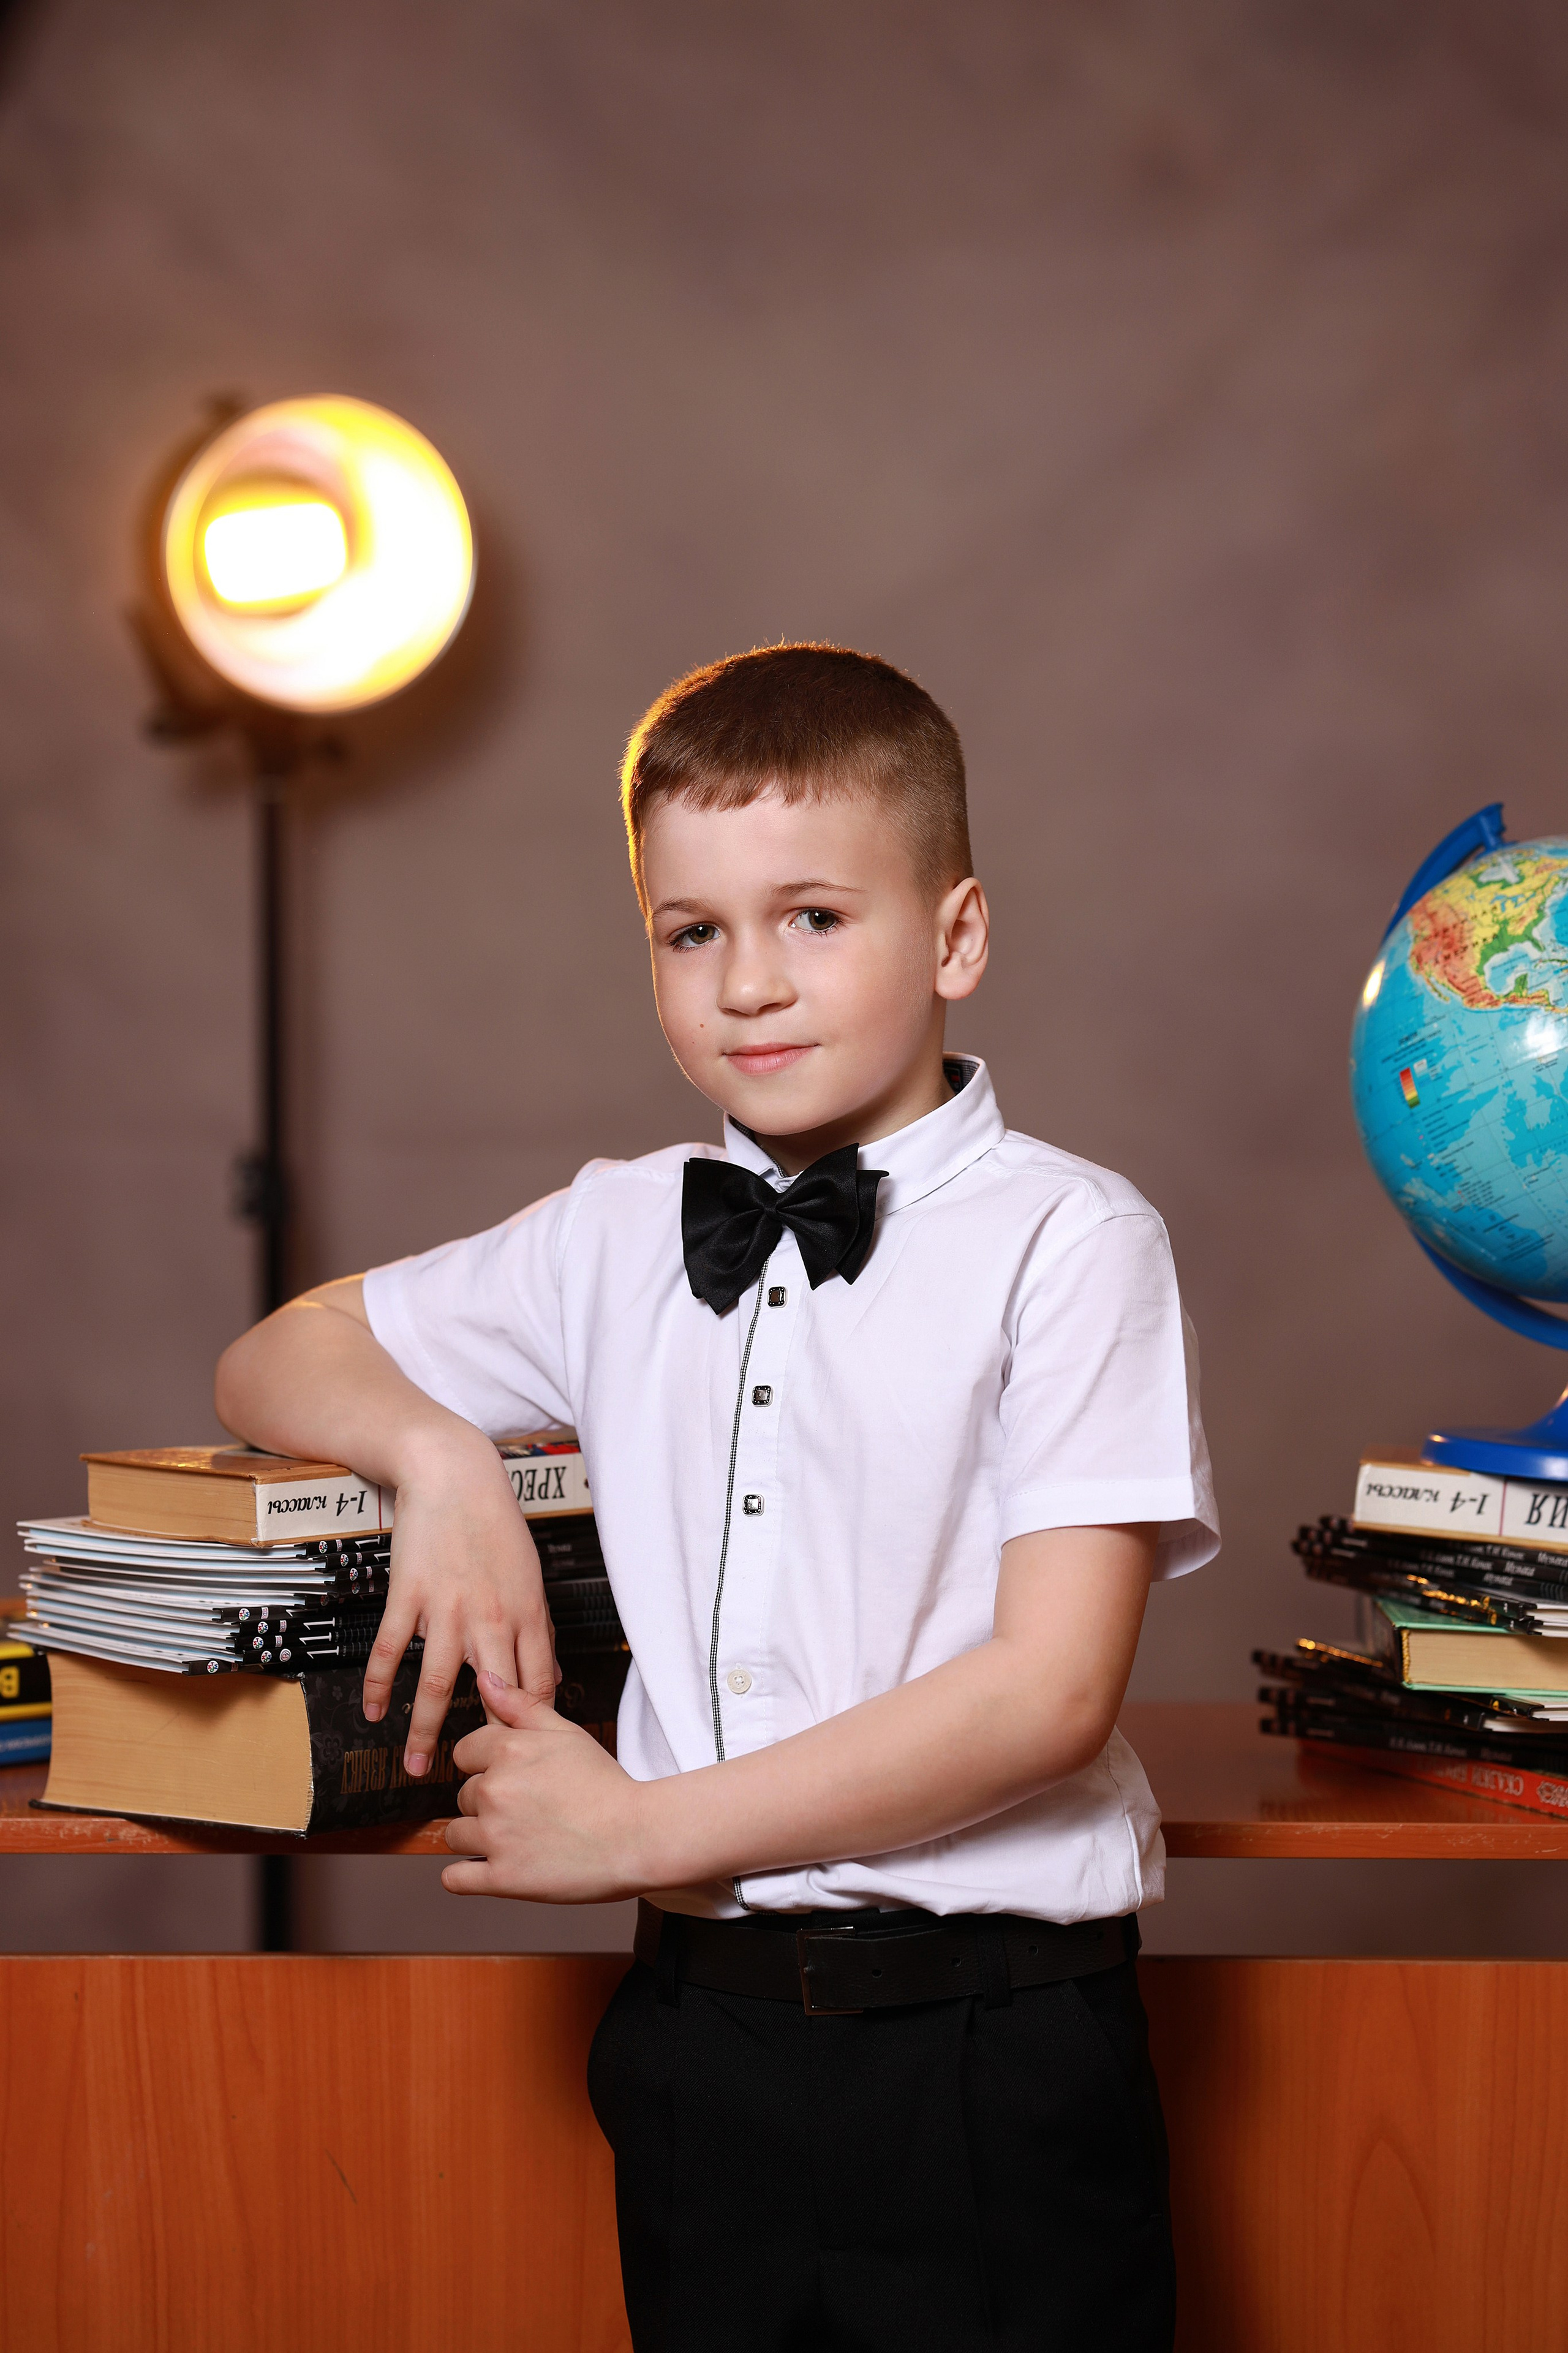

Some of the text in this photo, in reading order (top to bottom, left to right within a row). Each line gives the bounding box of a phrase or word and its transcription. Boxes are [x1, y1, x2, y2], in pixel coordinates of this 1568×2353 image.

[267, 1489, 368, 1517] 1-4 классы
[1366, 1483, 1490, 1517] 1-4 классы
